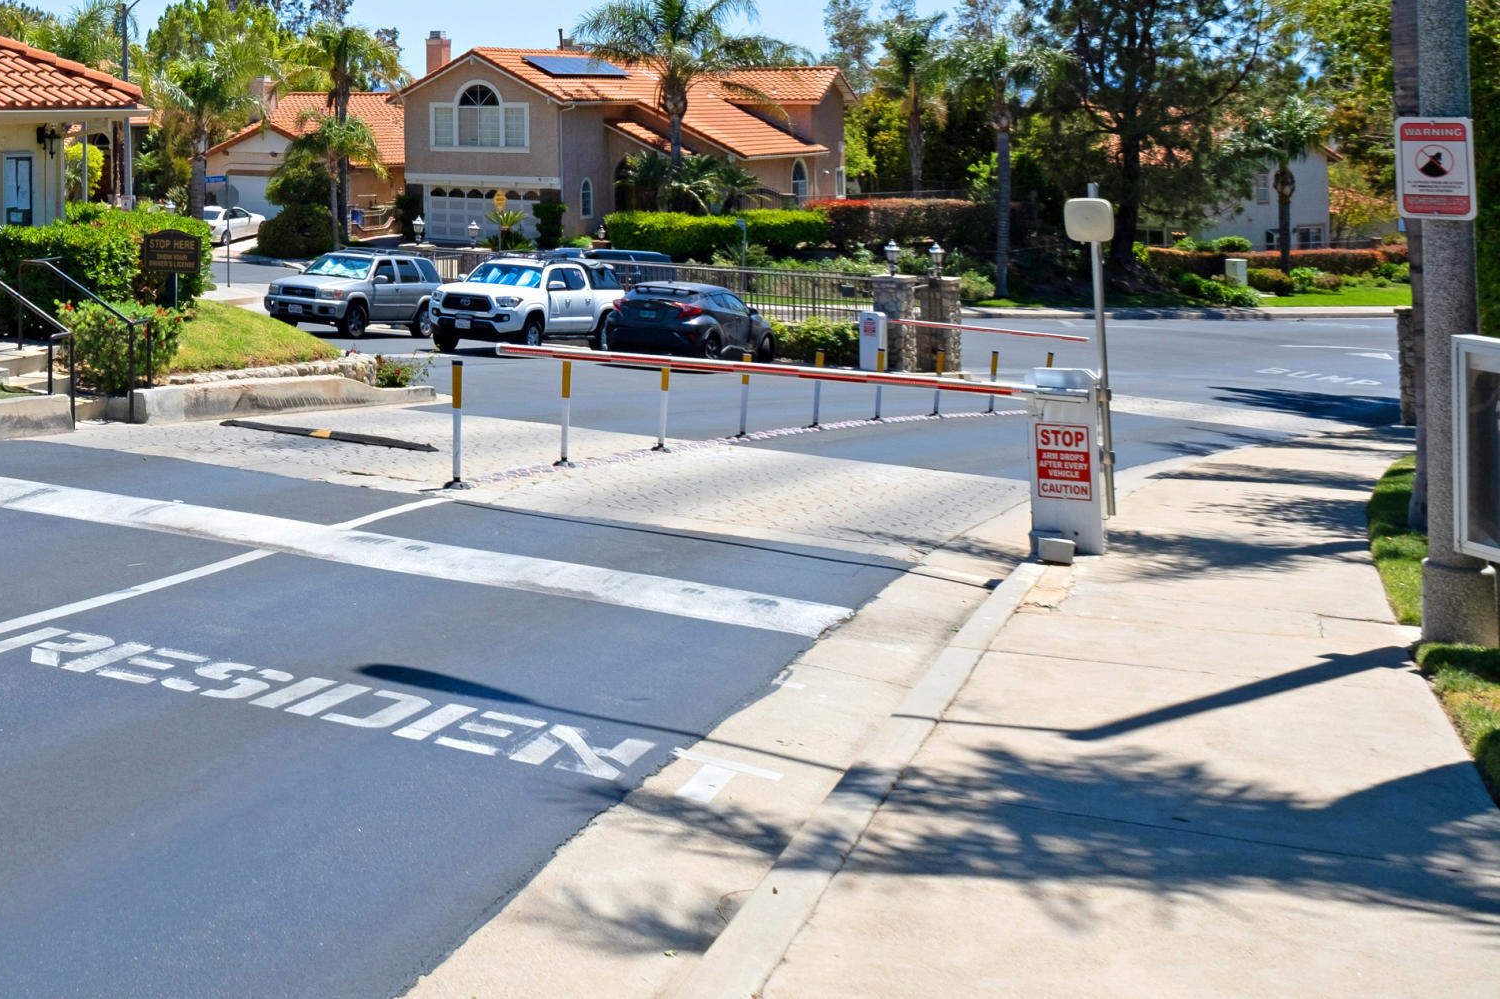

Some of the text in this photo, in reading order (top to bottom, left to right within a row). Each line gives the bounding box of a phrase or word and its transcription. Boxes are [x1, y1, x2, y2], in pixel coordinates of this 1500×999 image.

[1404, 128, 1463, 137] WARNING
[149, 239, 195, 250] STOP HERE
[1254, 367, 1383, 386] BUMP
[1040, 429, 1085, 447] STOP
[1060, 453, 1084, 461] DROPS
[1039, 460, 1088, 470] AFTER EVERY
[1049, 469, 1080, 478] VEHICLE
[1042, 483, 1088, 495] CAUTION
